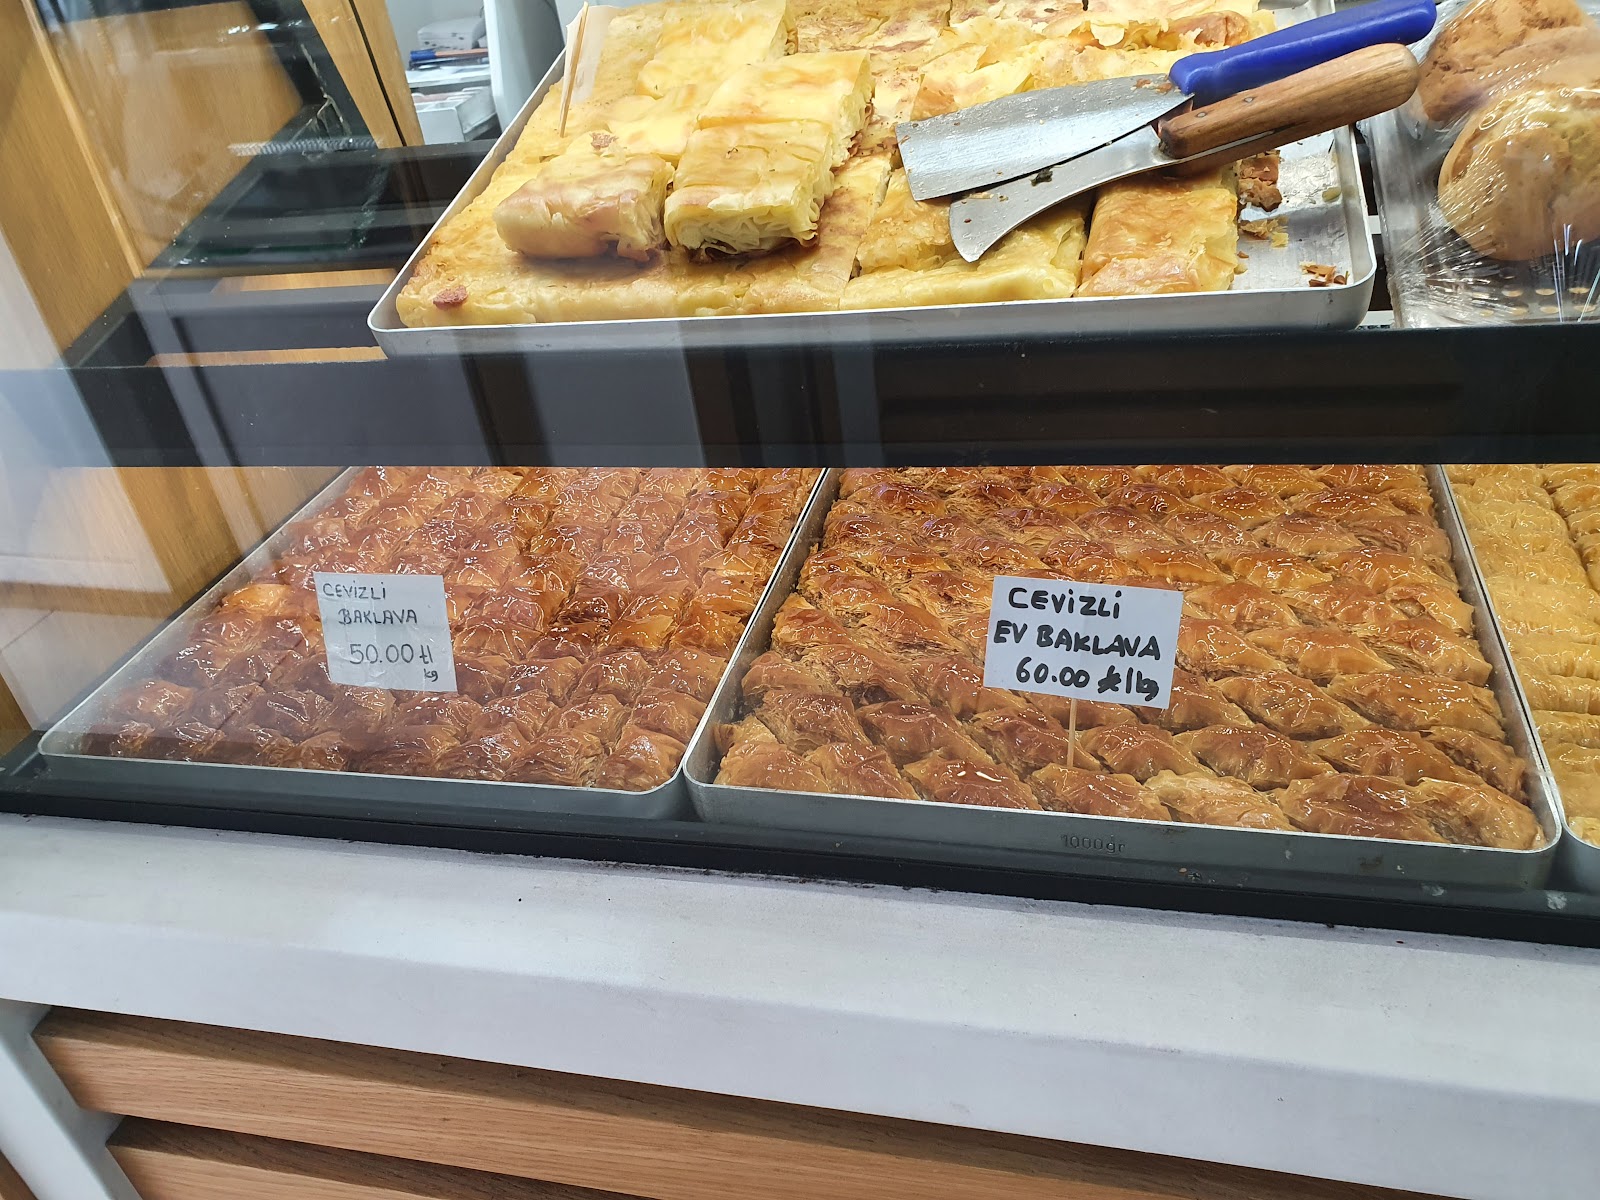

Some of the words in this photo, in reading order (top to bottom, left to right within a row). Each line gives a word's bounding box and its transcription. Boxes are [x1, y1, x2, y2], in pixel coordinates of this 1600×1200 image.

[338, 608, 418, 625] BAKLAVA
[993, 620, 1028, 644] EV
[1036, 624, 1161, 661] BAKLAVA
[423, 668, 439, 682] kg
[1016, 656, 1090, 689] 60.00
